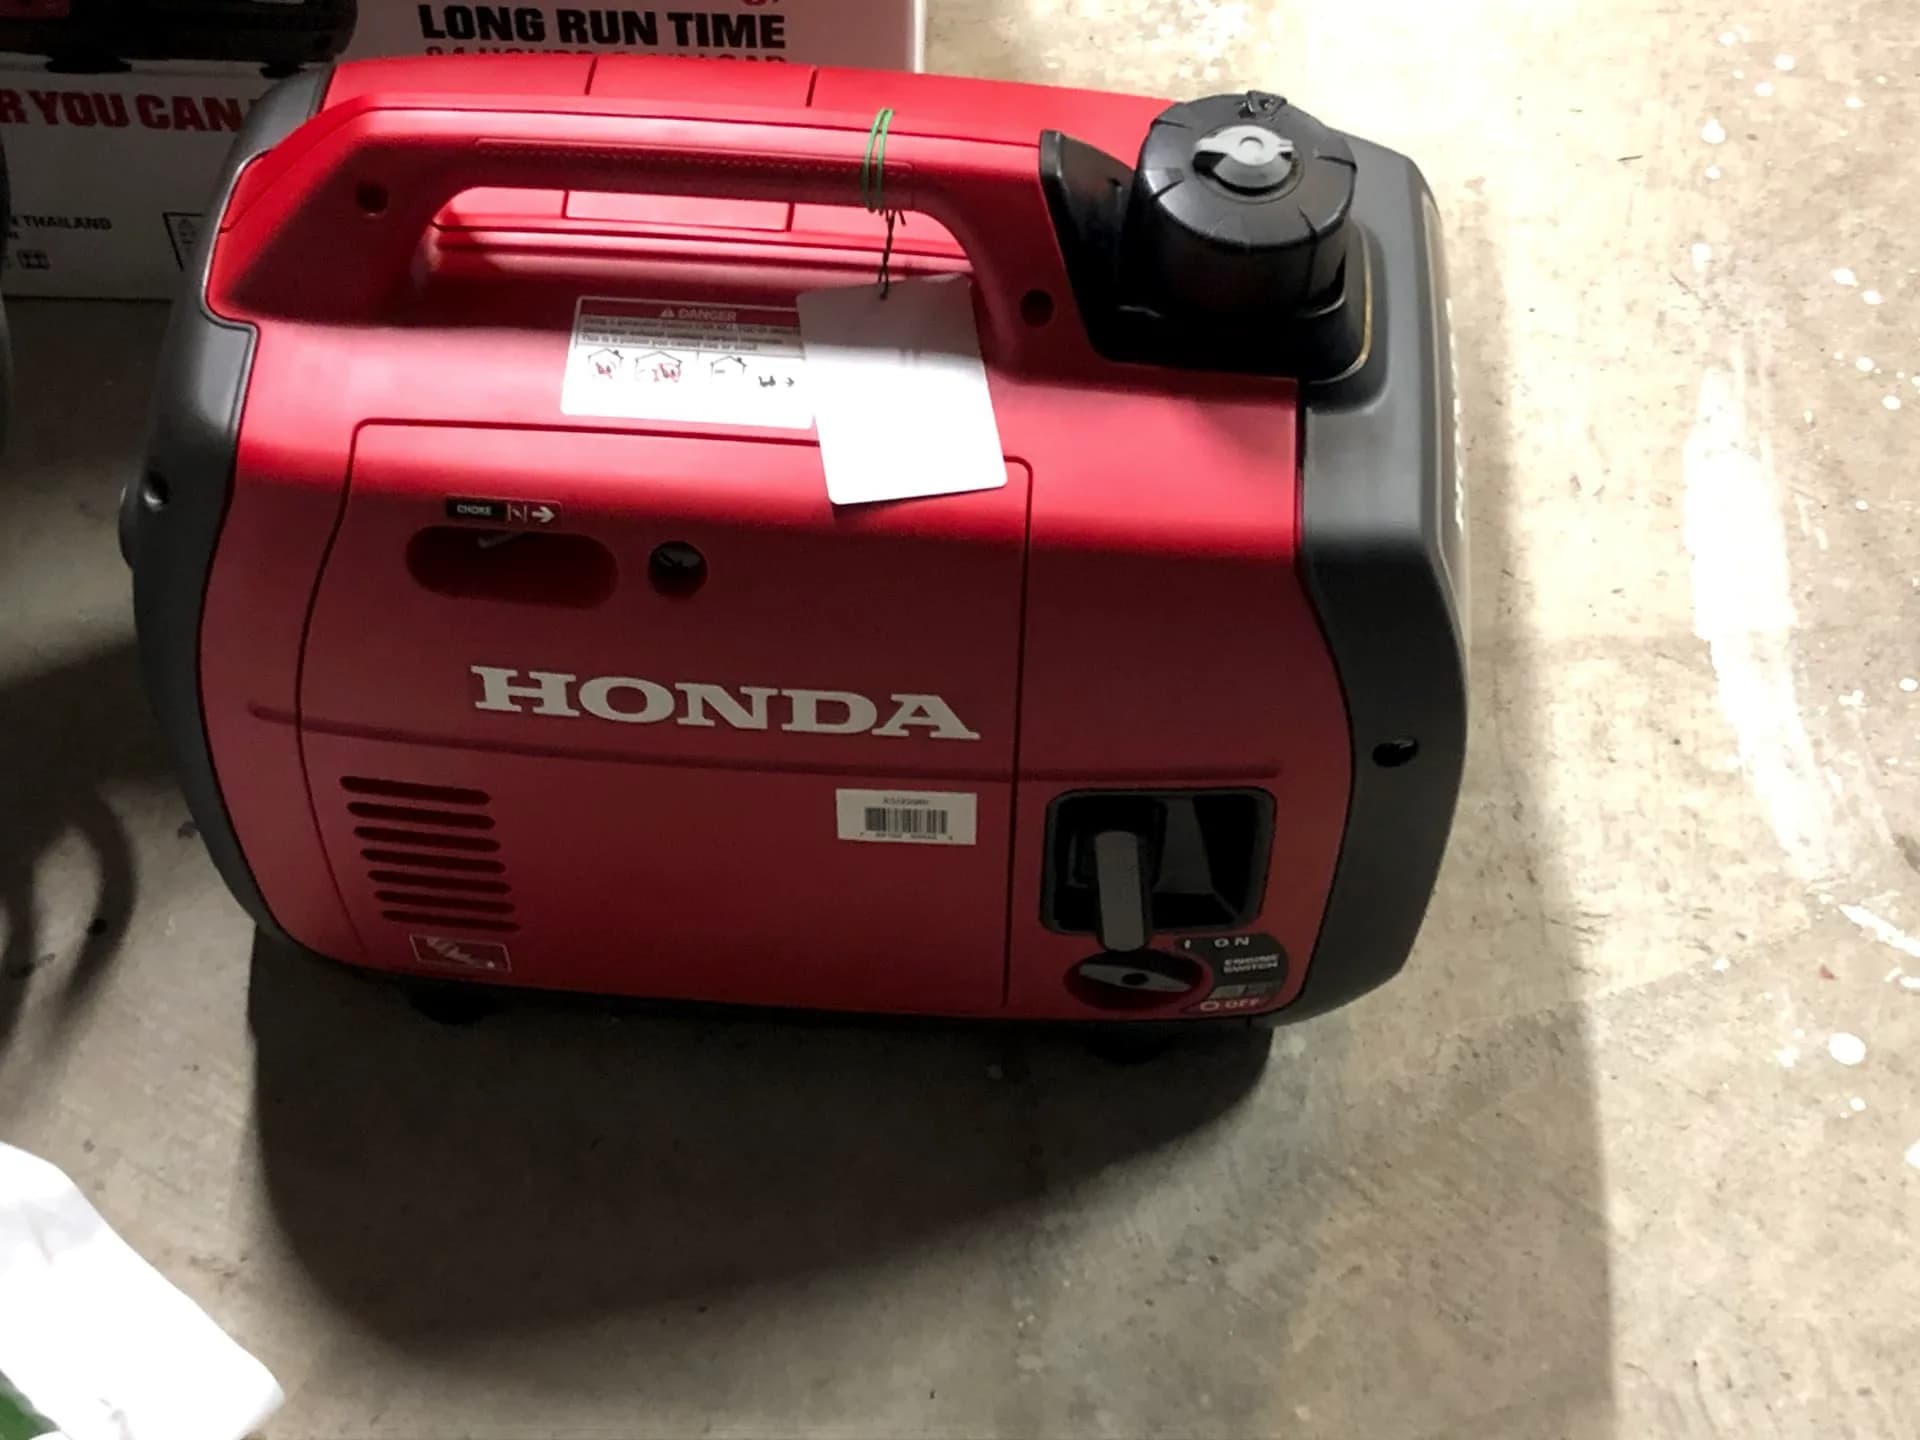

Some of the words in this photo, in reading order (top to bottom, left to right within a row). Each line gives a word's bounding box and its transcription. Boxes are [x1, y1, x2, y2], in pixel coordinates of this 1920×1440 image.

[418, 4, 546, 42] LONG
[556, 9, 658, 46] RUN
[667, 12, 786, 49] TIME
[27, 90, 130, 127] YOU
[136, 94, 242, 132] CAN
[23, 216, 112, 230] THAILAND
[677, 308, 737, 321] DANGER
[457, 504, 493, 516] CHOKE
[470, 665, 981, 740] HONDA
[1214, 936, 1250, 948] ON
[1225, 998, 1261, 1009] OFF
